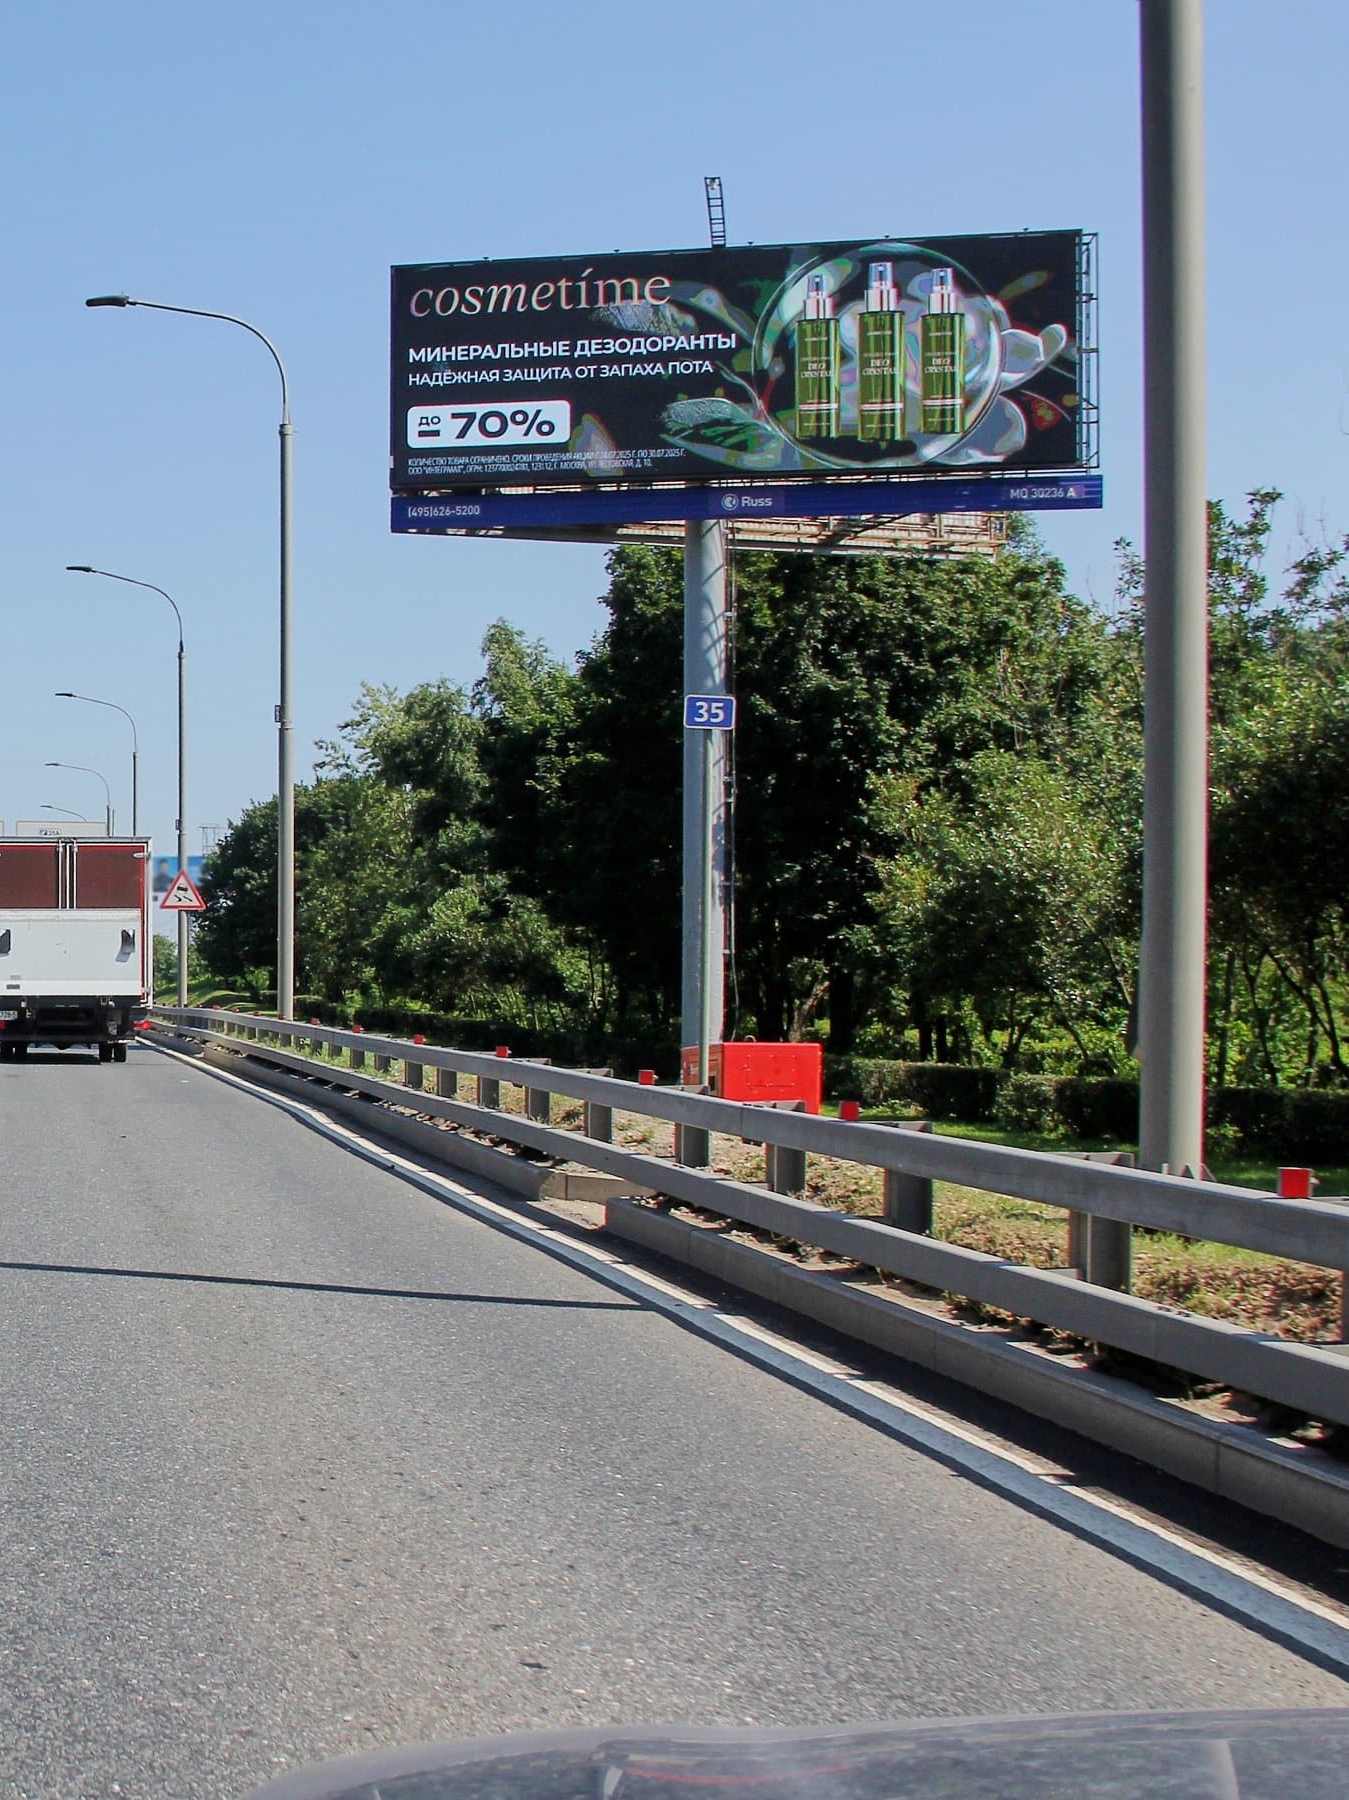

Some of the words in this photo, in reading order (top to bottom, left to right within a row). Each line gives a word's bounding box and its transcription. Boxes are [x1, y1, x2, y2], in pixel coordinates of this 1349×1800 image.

[408, 340, 571, 363] МИНЕРАЛЬНЫЕ
[574, 333, 737, 358] ДЕЗОДОРАНТЫ
[408, 369, 500, 387] НАДЁЖНАЯ
[503, 366, 572, 384] ЗАЩИТА
[574, 365, 597, 378] ОТ
[599, 362, 665, 377] ЗАПАХА
[668, 360, 714, 374] ПОТА
[450, 409, 555, 440] 70%
[741, 496, 773, 507] Russ
[1030, 487, 1065, 498] 30236
[408, 505, 480, 517] (495)626-5200
[694, 701, 725, 723] 35
